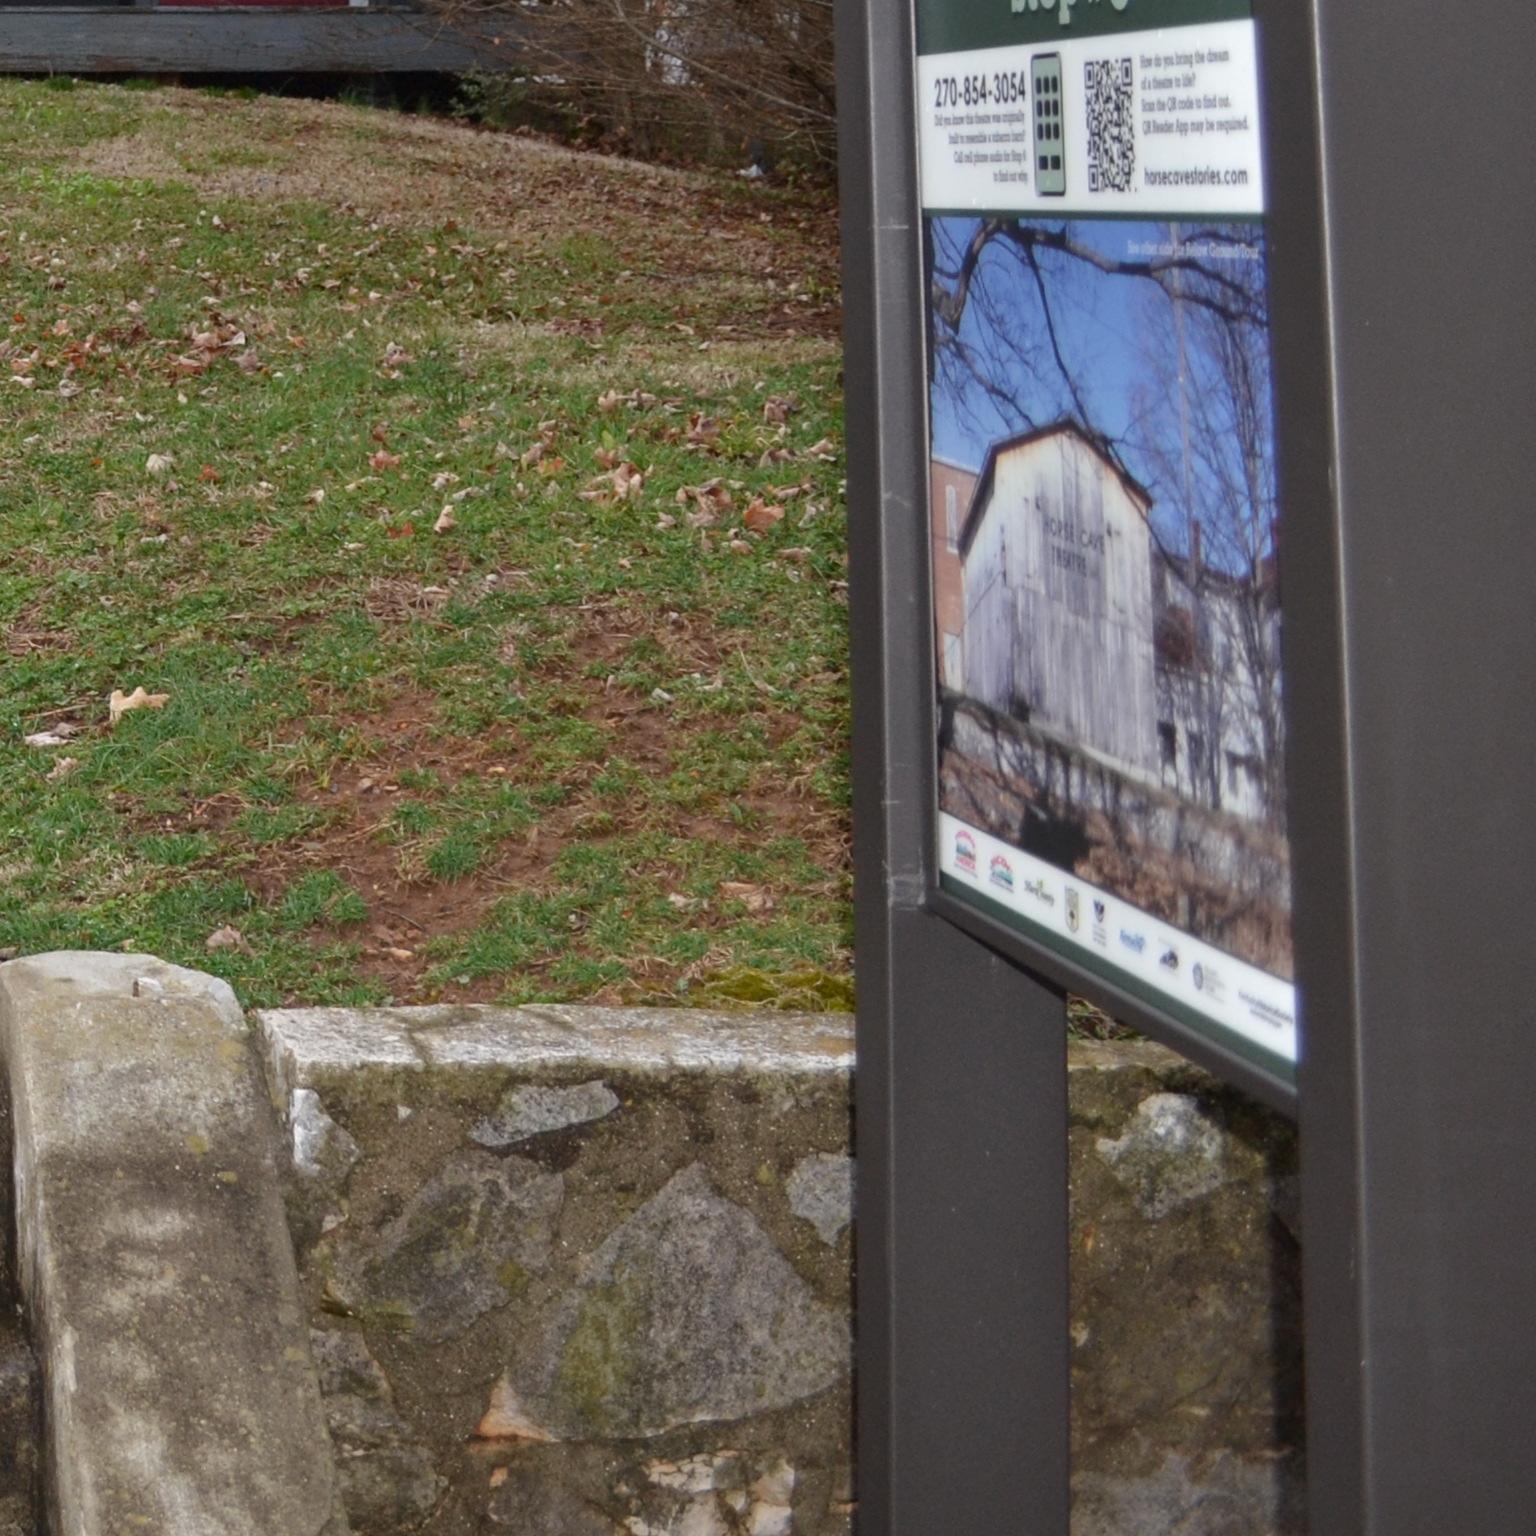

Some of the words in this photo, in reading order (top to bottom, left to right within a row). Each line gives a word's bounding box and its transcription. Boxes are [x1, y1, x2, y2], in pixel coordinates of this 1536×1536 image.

[934, 71, 1026, 107] 270-854-3054
[1167, 96, 1176, 111] QR
[1175, 118, 1188, 135] App
[1144, 166, 1249, 186] horsecavestories.com
